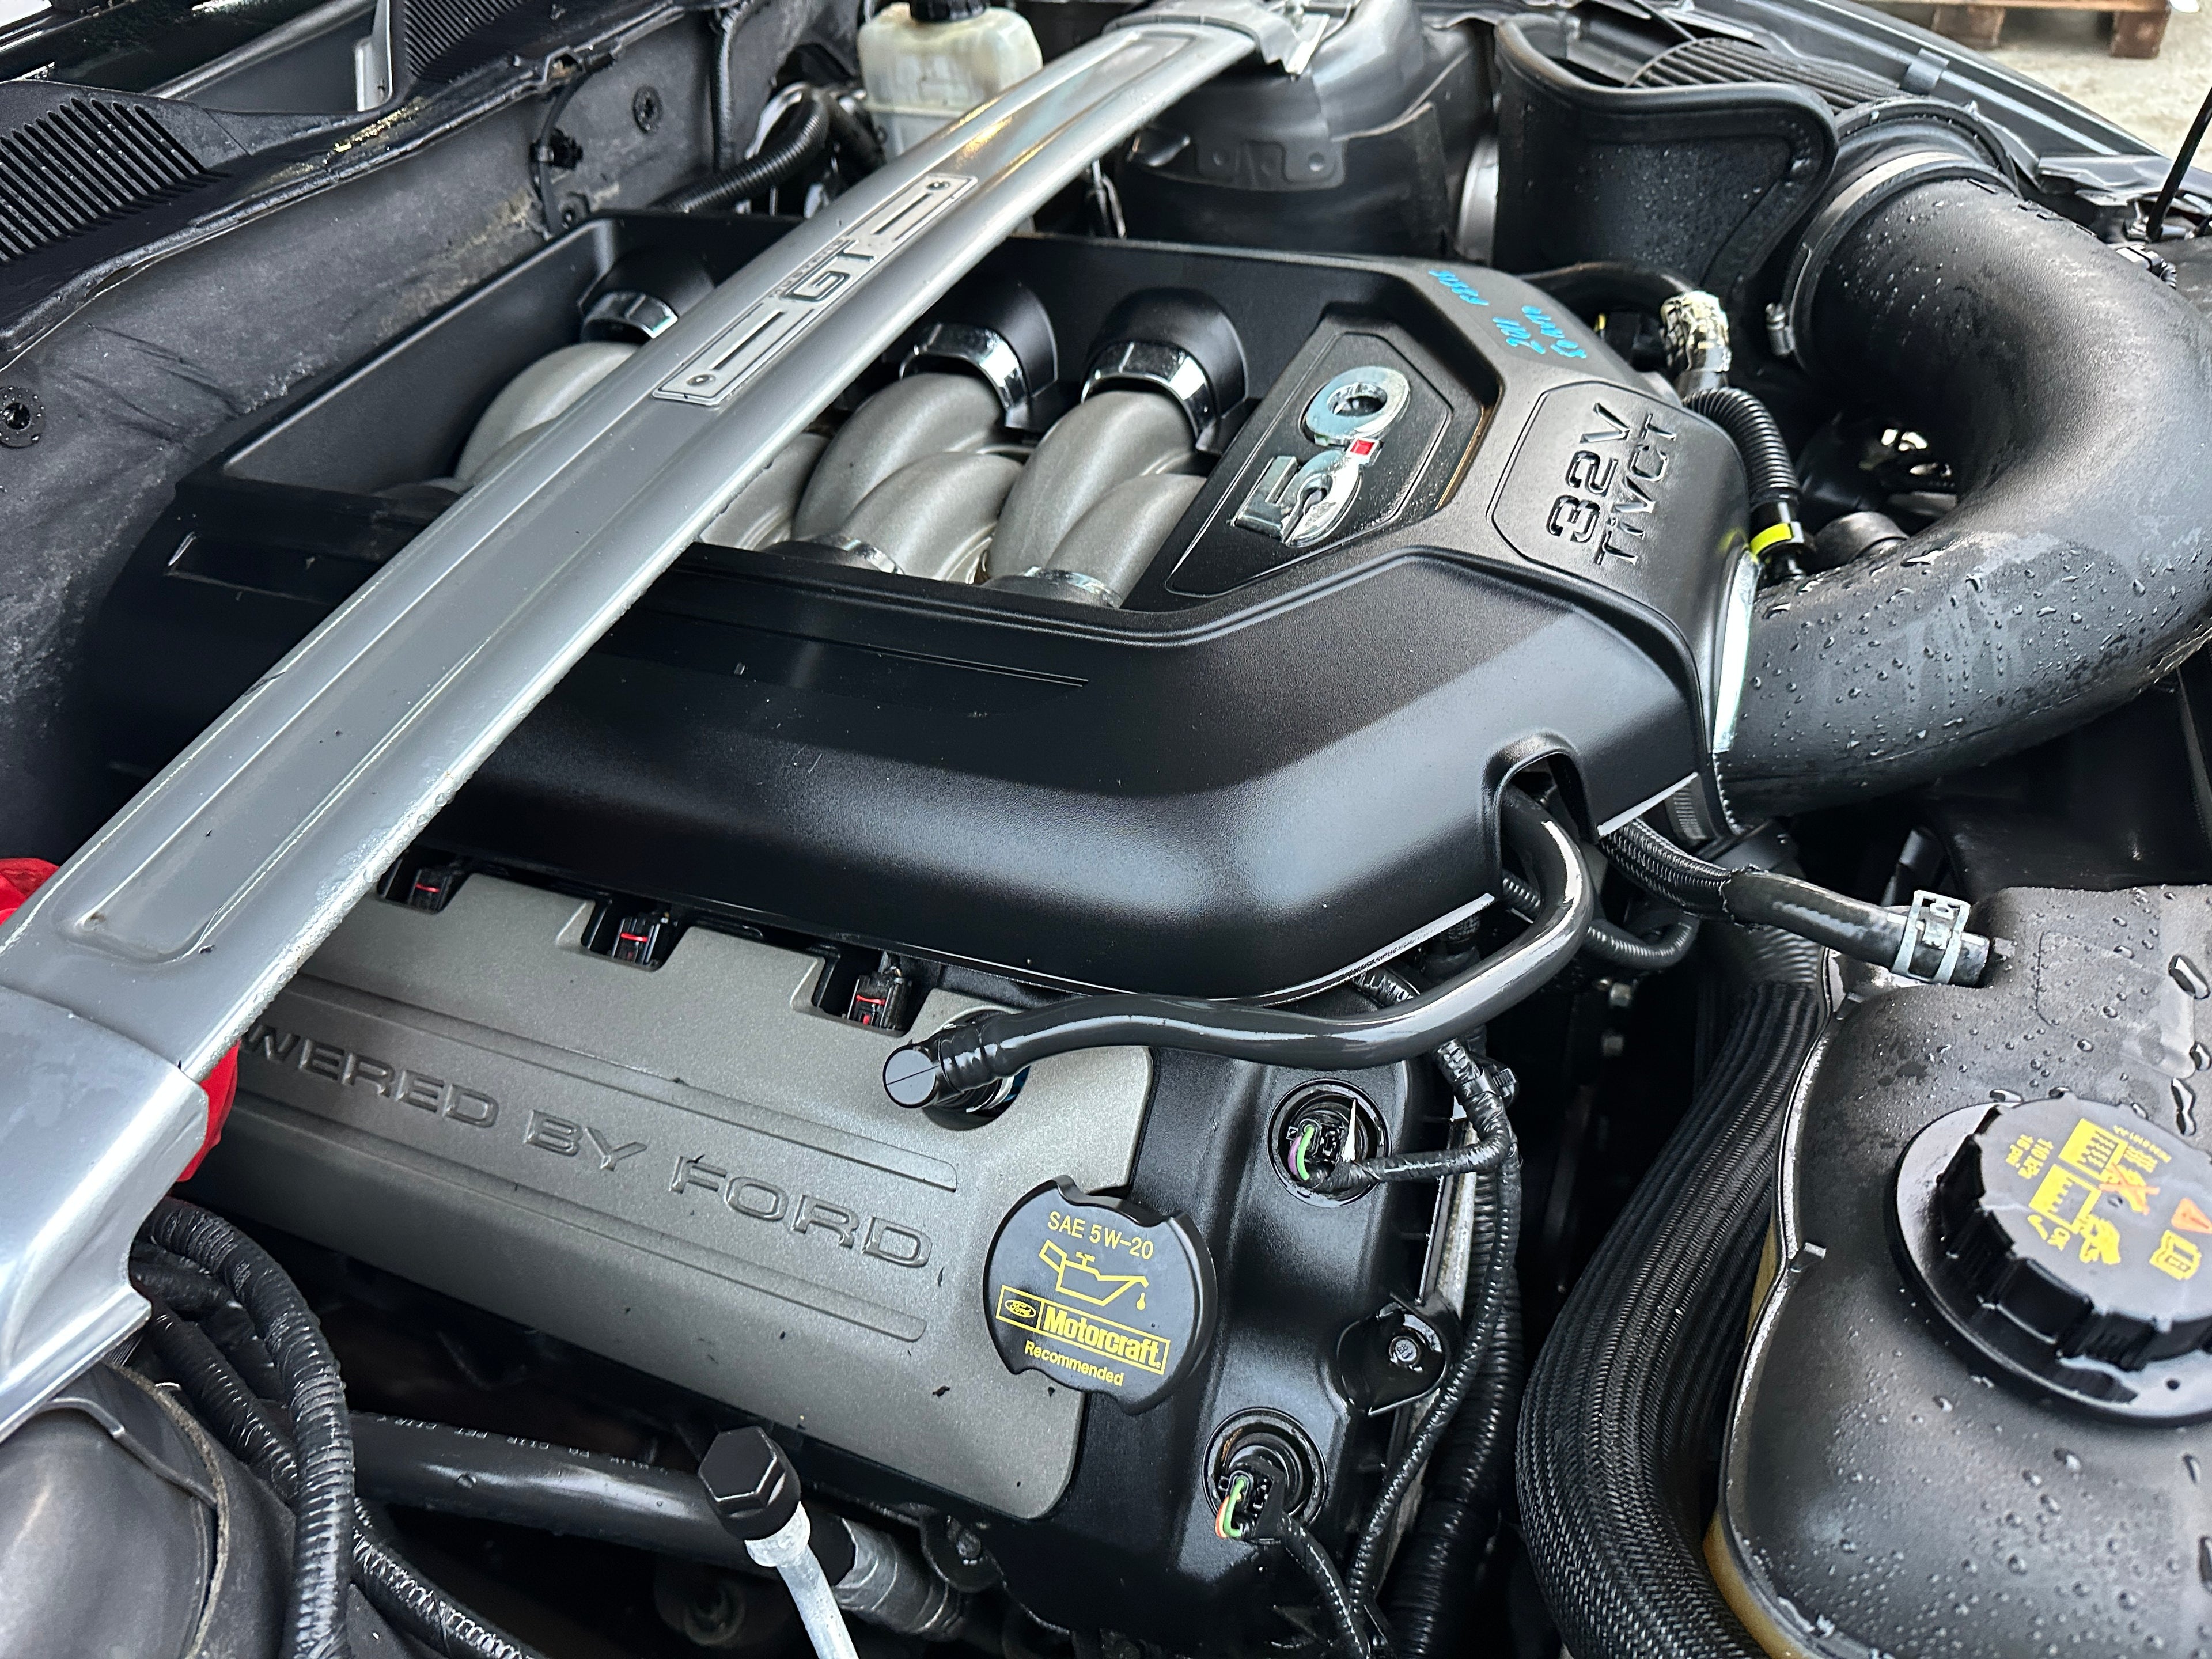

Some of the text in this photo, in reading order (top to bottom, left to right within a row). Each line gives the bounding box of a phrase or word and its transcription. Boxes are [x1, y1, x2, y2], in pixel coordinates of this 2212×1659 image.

[779, 239, 878, 302] GT
[1227, 365, 1411, 548] 5.0
[1546, 402, 1631, 543] 32V
[522, 1109, 648, 1172] BY
[668, 1154, 933, 1268] FORD
[1048, 1211, 1154, 1260] SAE 5W-20
[2047, 1227, 2071, 1251] OK
[1008, 1301, 1160, 1368] Ford Motorcraft
[1024, 1340, 1124, 1387] Recommended
